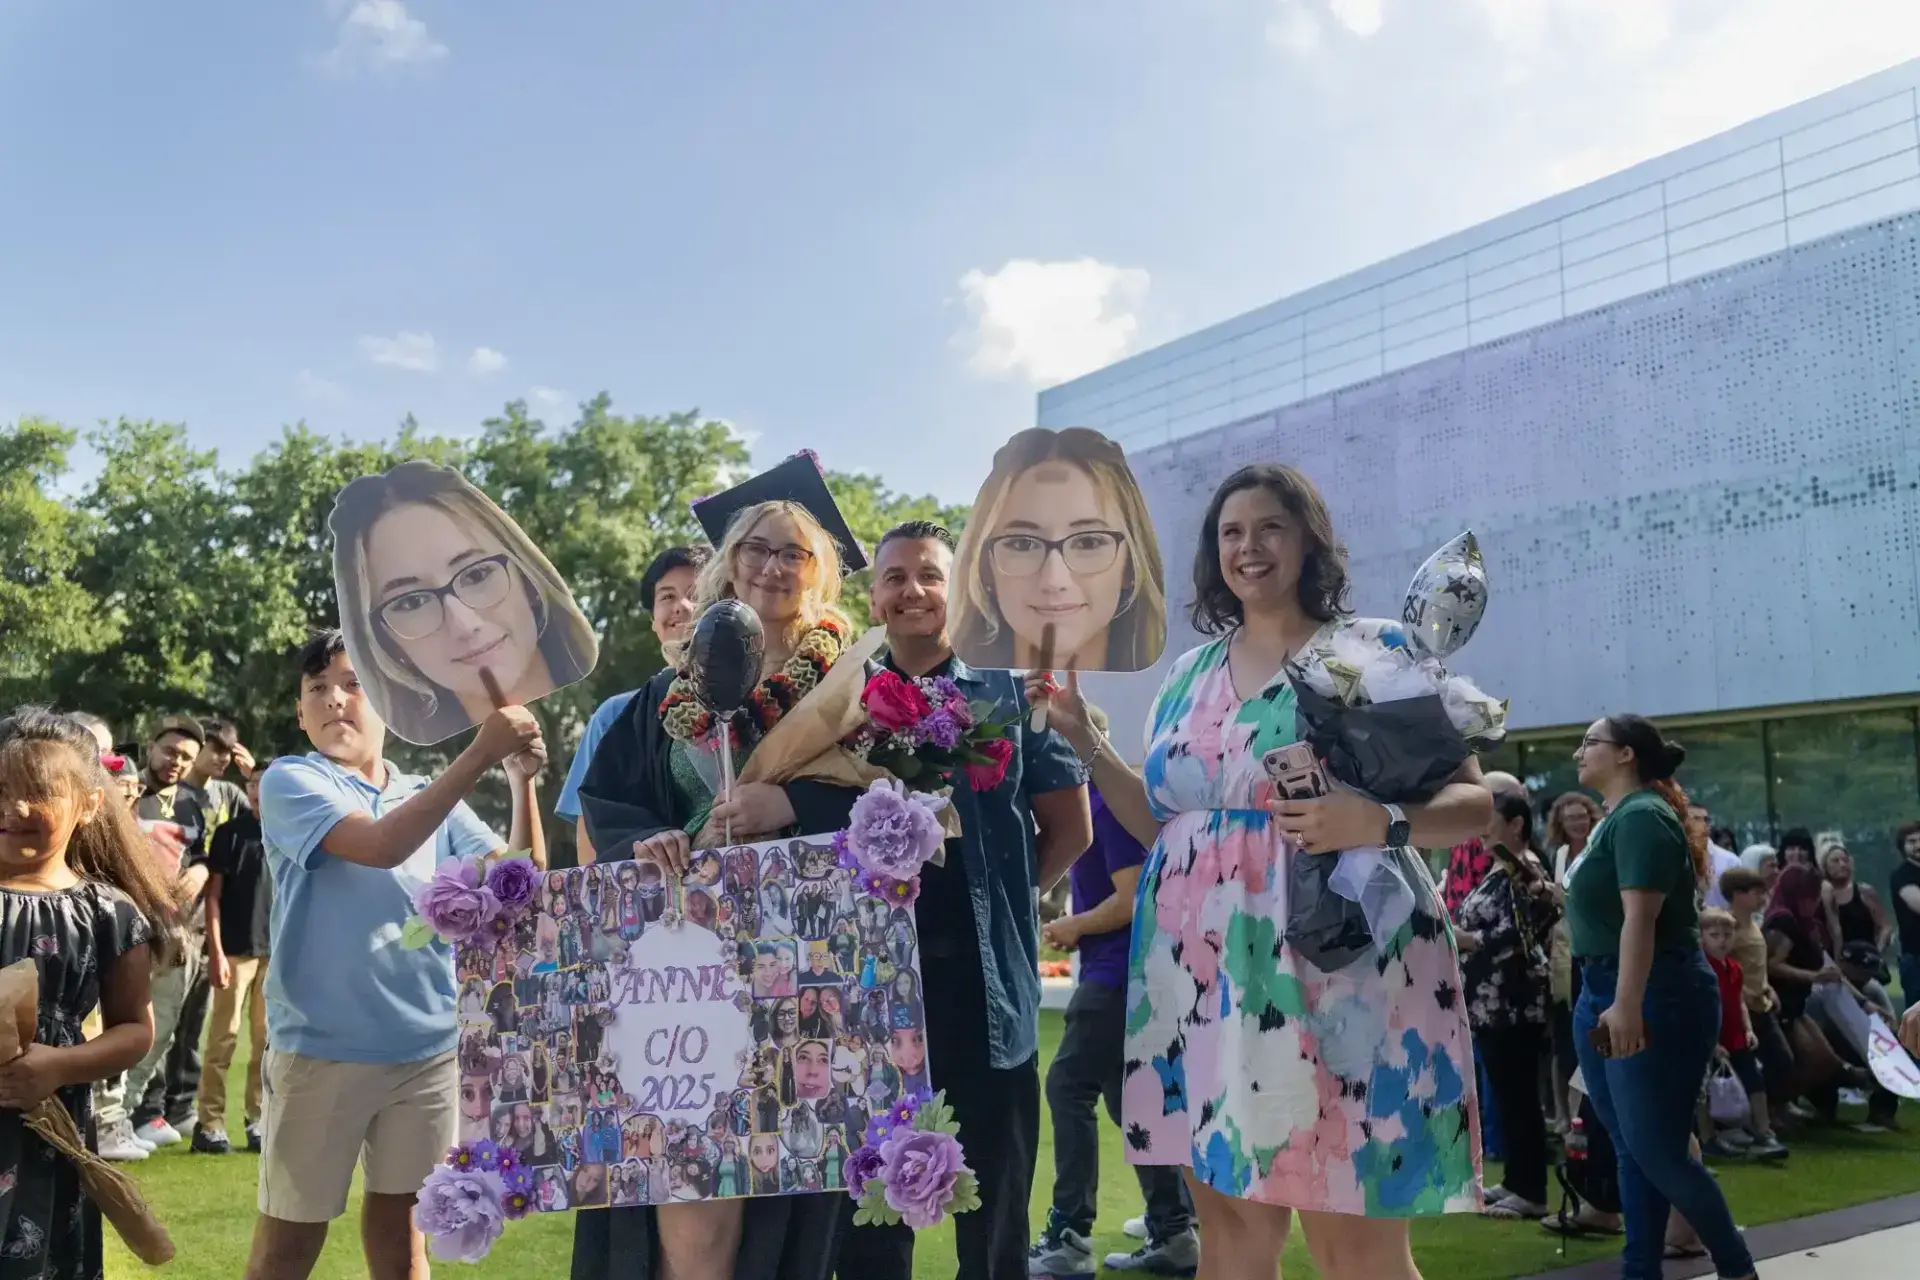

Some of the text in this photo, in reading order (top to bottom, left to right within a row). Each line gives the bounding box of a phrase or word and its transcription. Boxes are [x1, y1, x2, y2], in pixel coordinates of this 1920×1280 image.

[609, 964, 738, 1010] ANNIE
[644, 1024, 709, 1068] C/O
[637, 1072, 716, 1112] 2025
